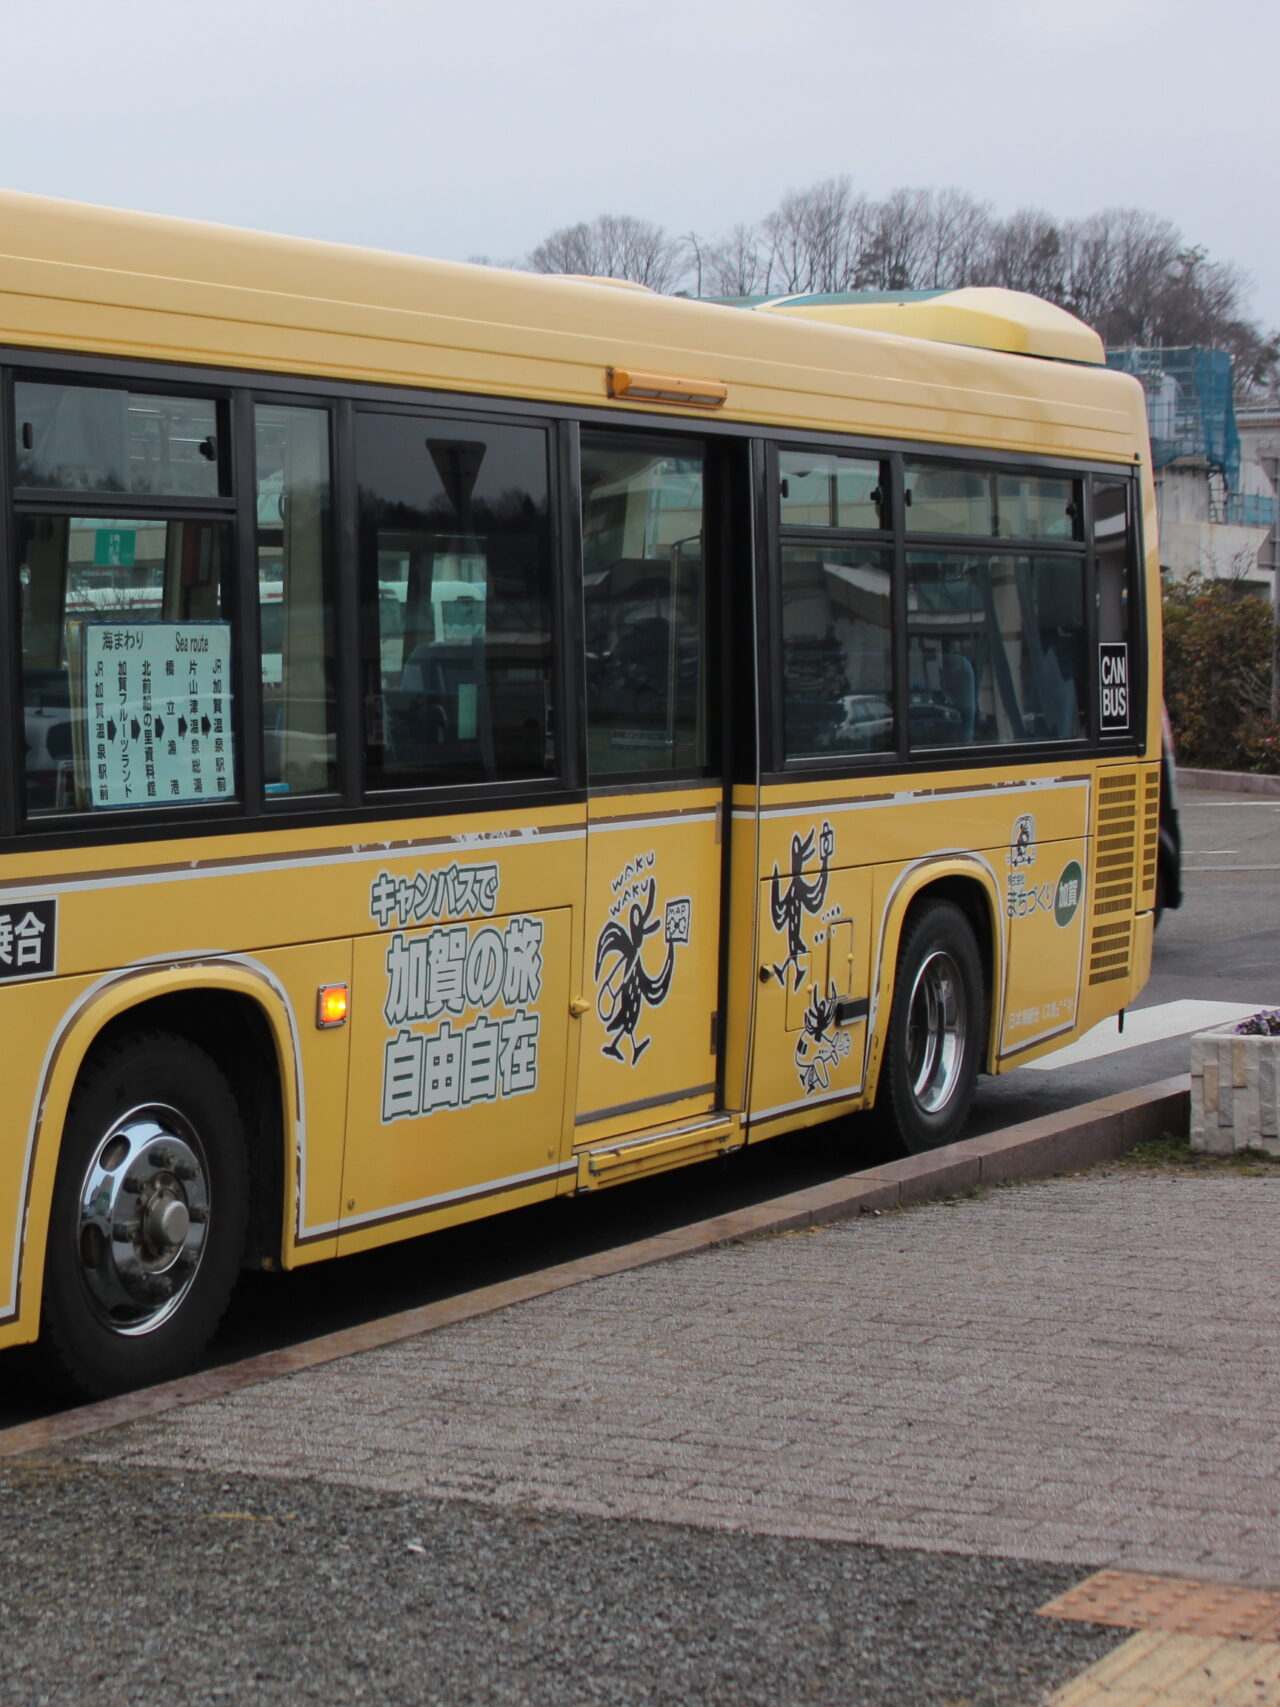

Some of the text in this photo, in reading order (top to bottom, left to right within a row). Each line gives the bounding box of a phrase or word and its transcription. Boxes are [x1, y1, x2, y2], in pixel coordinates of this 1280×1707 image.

[102, 630, 144, 651] 海まわり
[175, 632, 209, 653] Sea route
[1101, 656, 1126, 685] CAN
[1103, 687, 1127, 716] BUS
[612, 852, 654, 892] WAKU
[371, 864, 499, 927] キャンバスで
[610, 880, 648, 916] WAKU
[669, 905, 686, 915] MAP
[384, 918, 543, 1026] 加賀の旅
[382, 1009, 540, 1122] 自由自在
